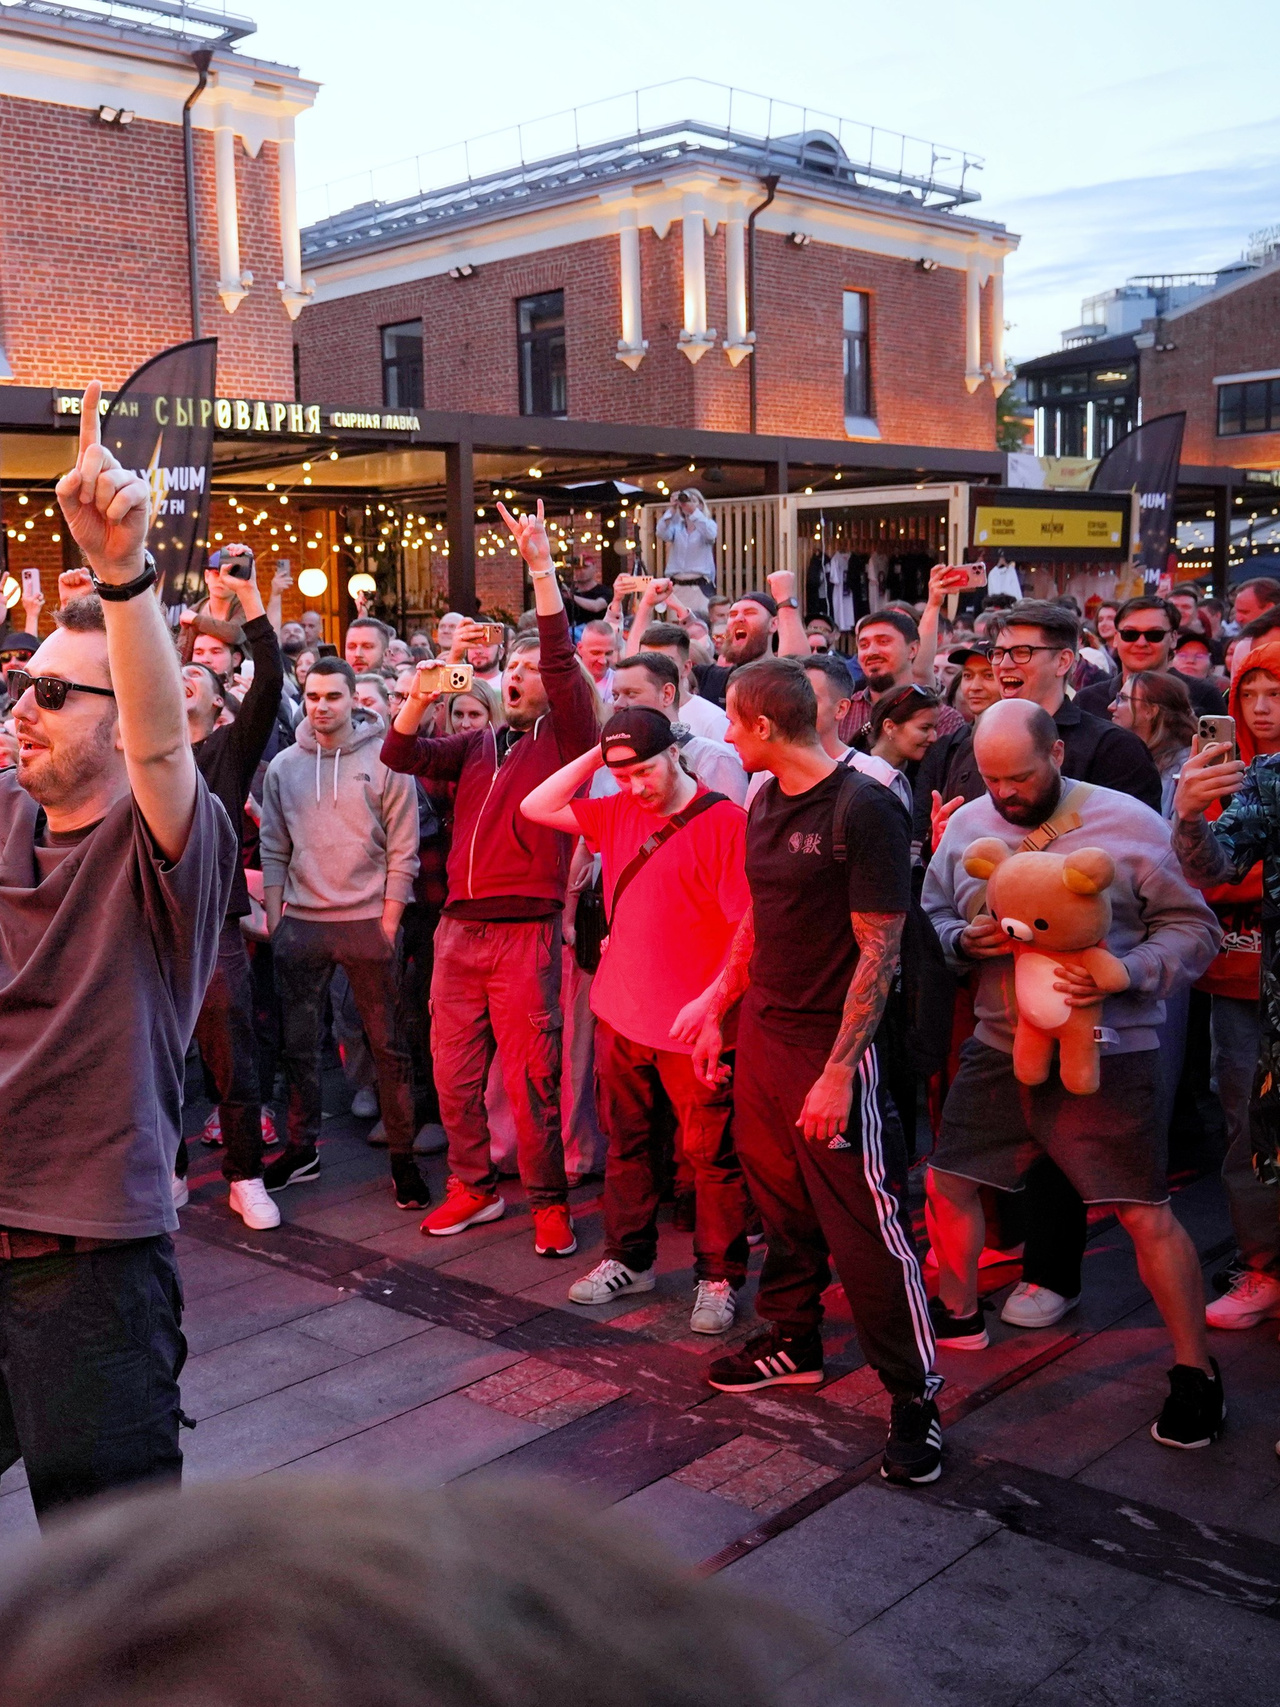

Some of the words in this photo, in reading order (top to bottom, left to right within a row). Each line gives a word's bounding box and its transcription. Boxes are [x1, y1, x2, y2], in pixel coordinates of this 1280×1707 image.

[154, 396, 321, 434] СЫРОВАРНЯ
[331, 411, 381, 428] СЫРНАЯ
[382, 414, 420, 431] ЛАВКА
